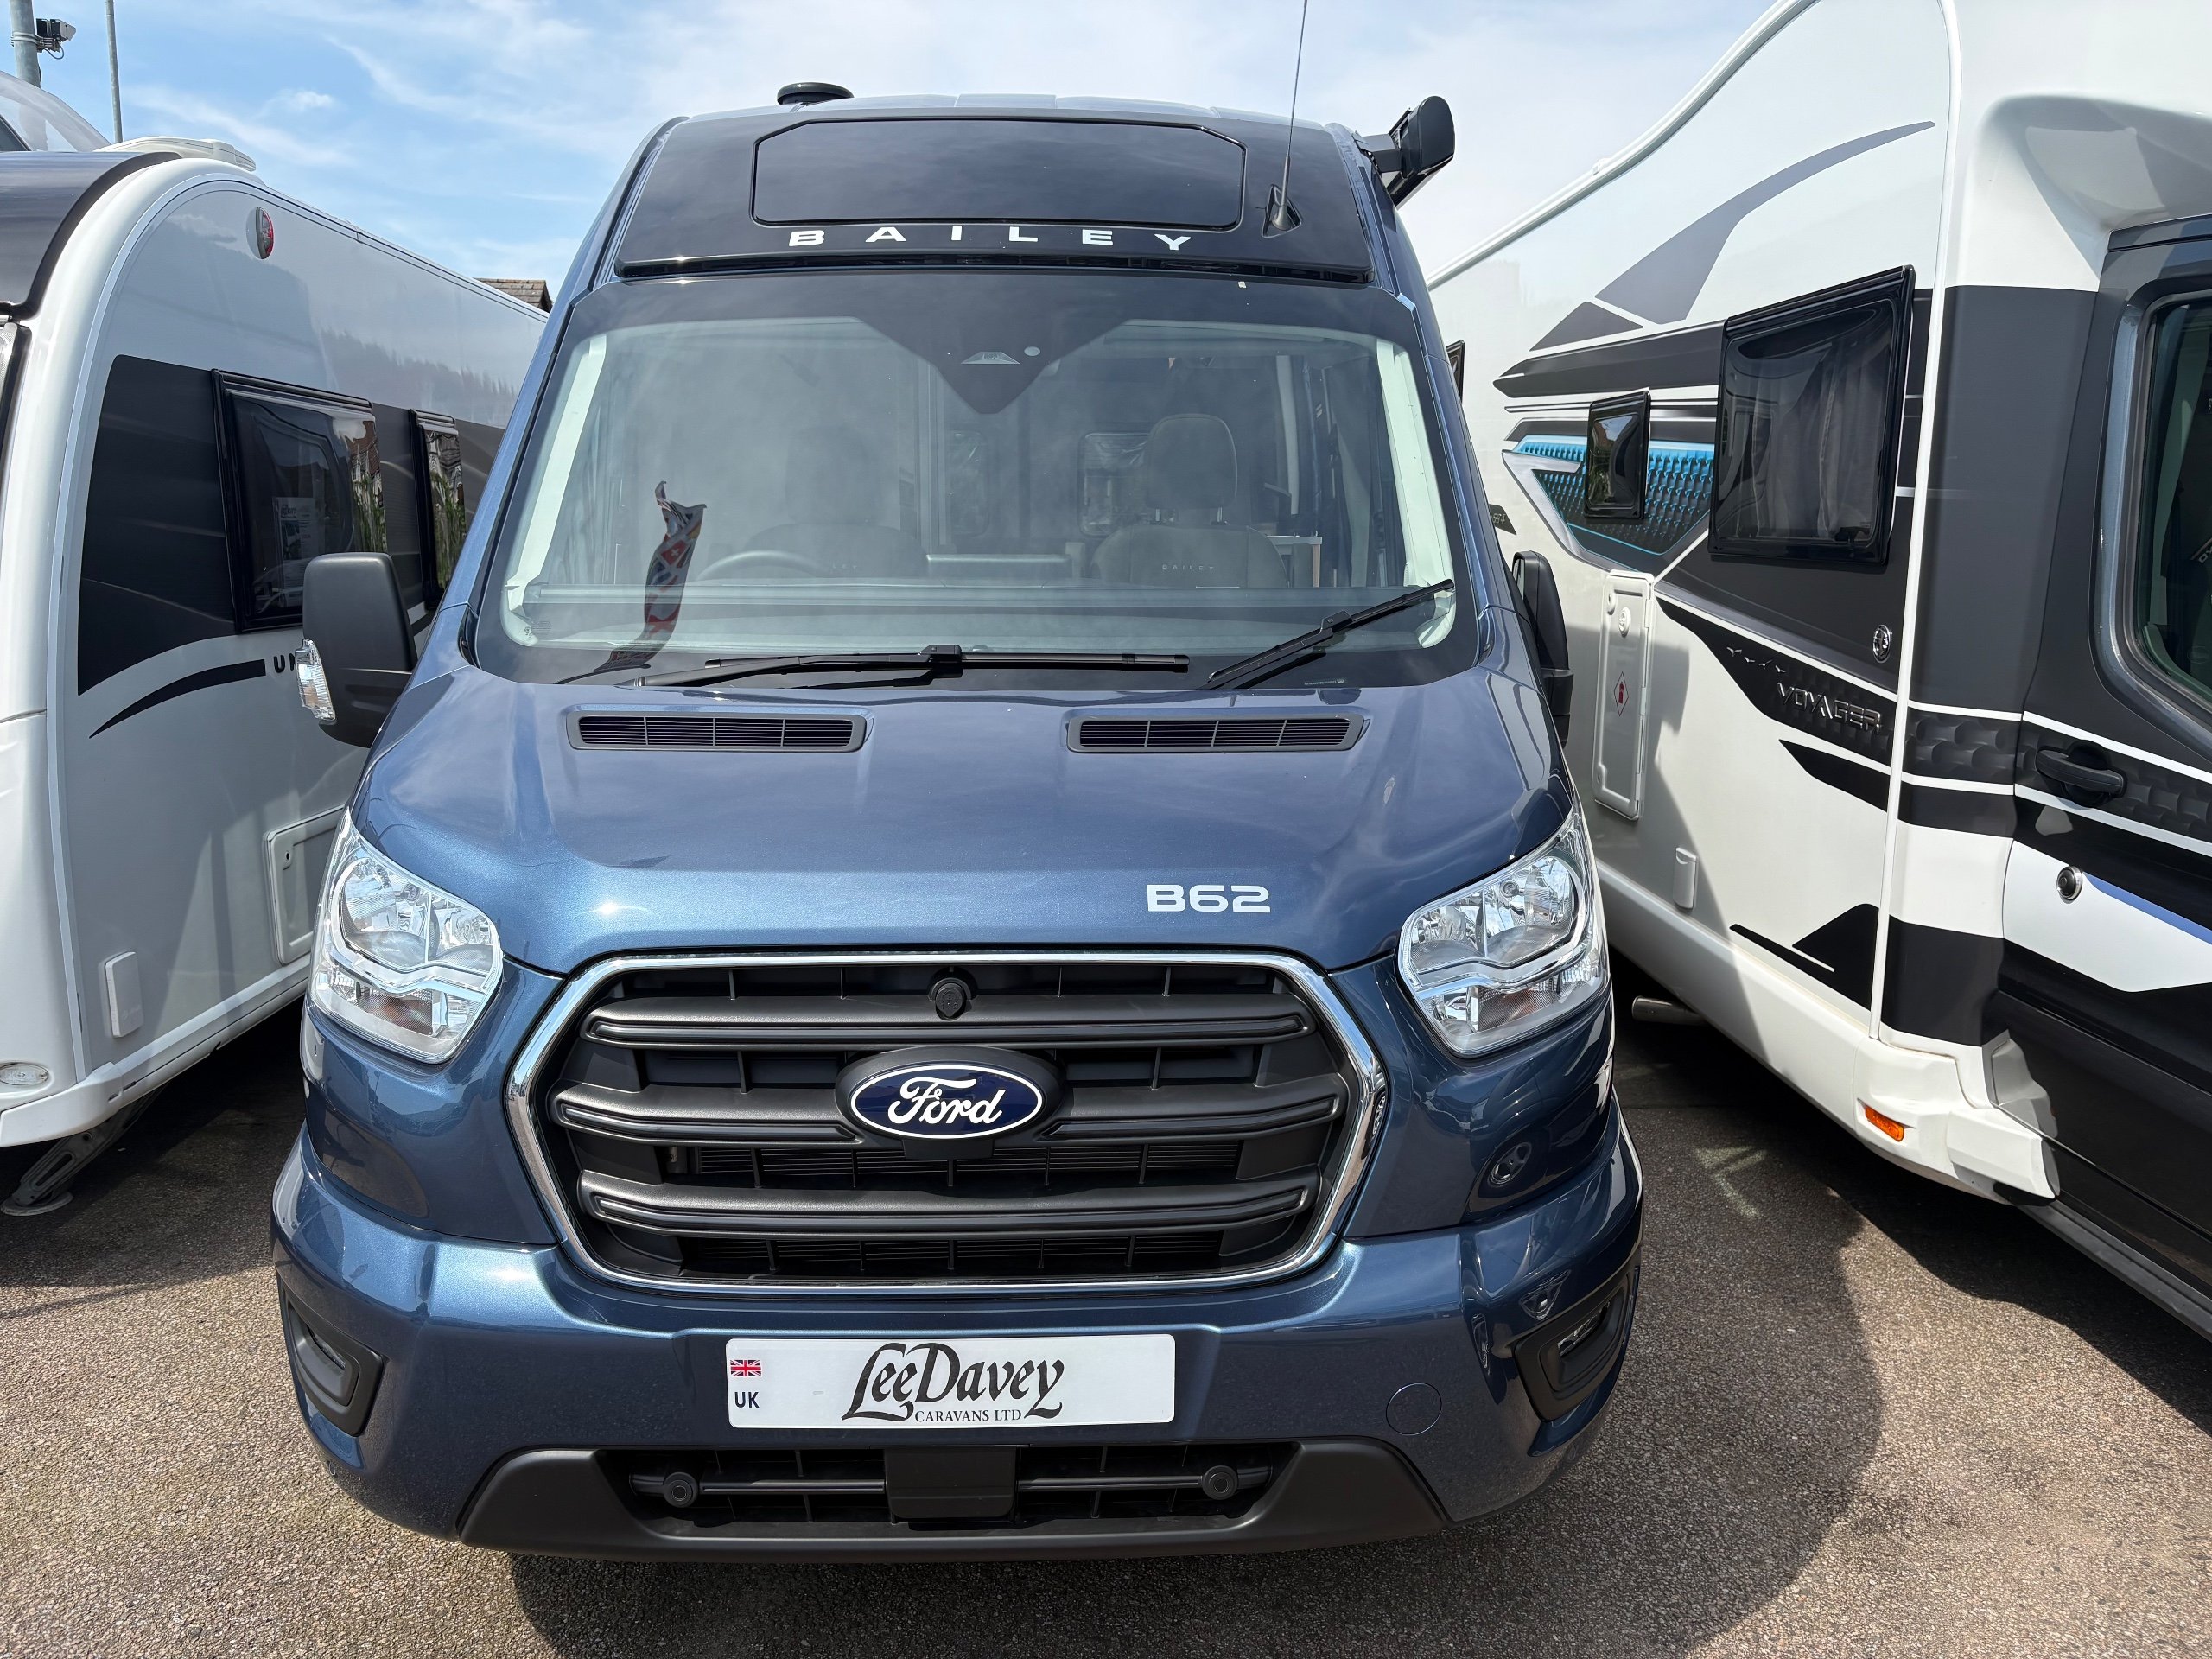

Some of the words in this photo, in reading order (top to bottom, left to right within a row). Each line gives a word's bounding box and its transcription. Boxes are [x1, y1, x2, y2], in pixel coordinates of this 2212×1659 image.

[788, 226, 1192, 251] BAILEY
[1777, 682, 1882, 734] VOYAGER
[1147, 884, 1271, 913] B62
[887, 1077, 1007, 1124] Ford
[734, 1391, 760, 1408] UK
[914, 1409, 990, 1422] CARAVANS
[994, 1408, 1022, 1421] LTD
